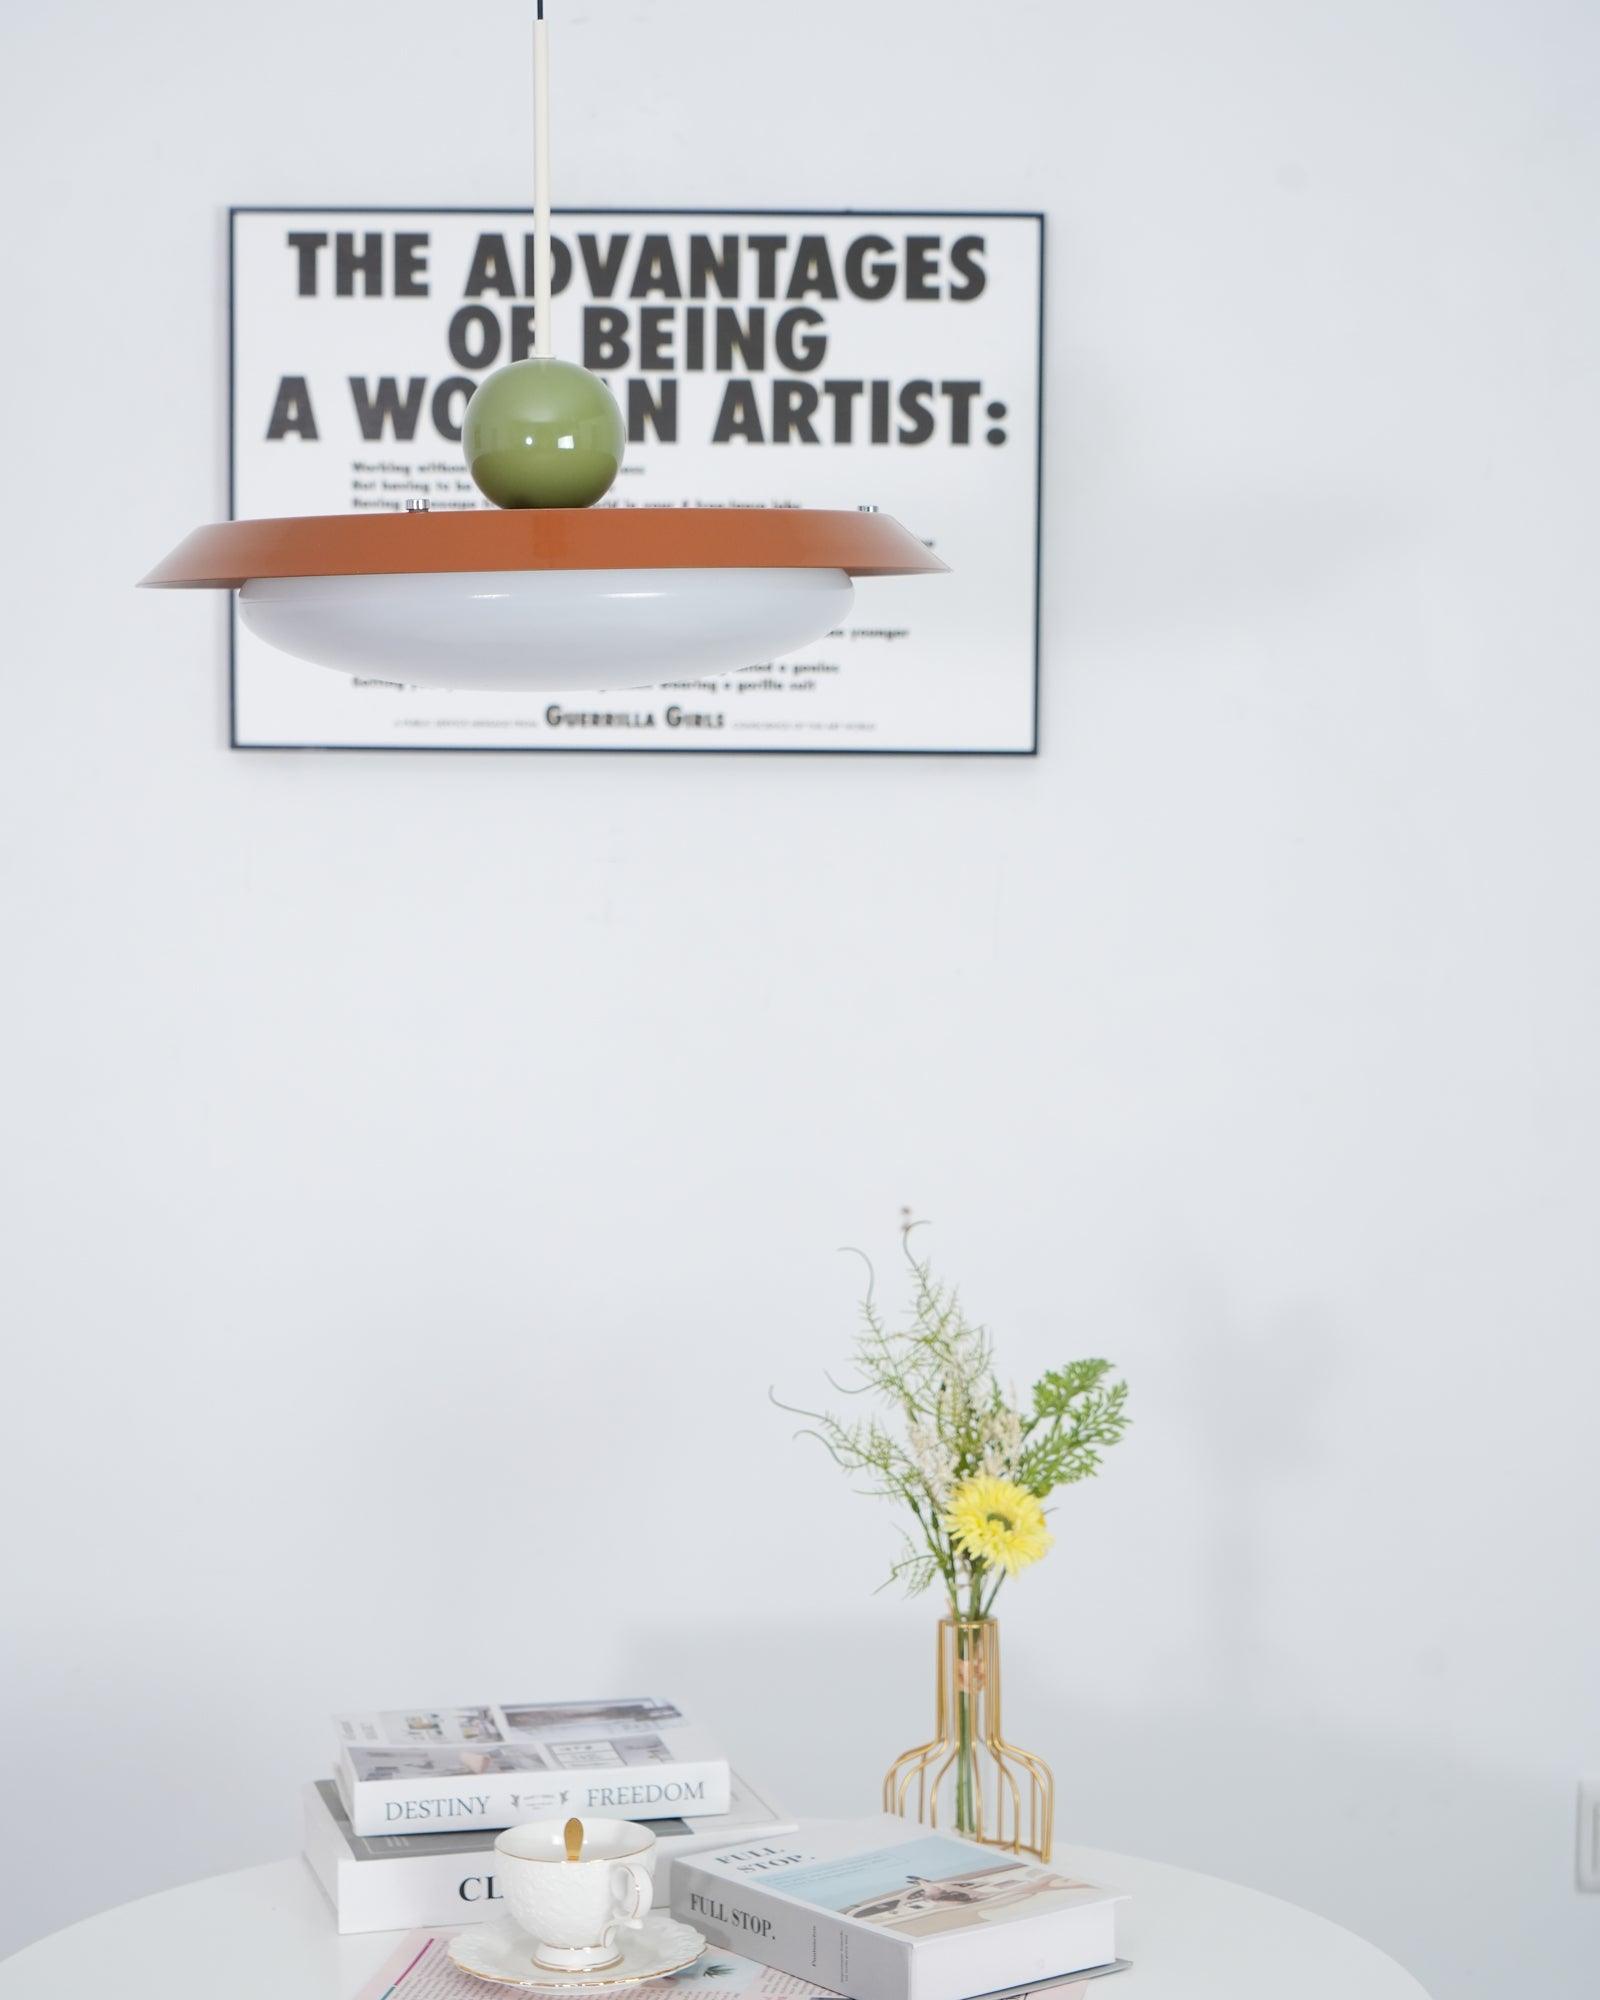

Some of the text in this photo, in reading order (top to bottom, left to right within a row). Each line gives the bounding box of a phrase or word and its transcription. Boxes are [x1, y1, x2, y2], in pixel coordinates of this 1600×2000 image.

[287, 231, 987, 302] THE ADVANTAGES
[582, 305, 829, 373] BEING
[265, 376, 1008, 448] A WON ARTIST:
[385, 1781, 705, 1821] DESTINY FREEDOM
[458, 1876, 504, 1902] CL
[690, 1893, 776, 1940] FULL STOP.
